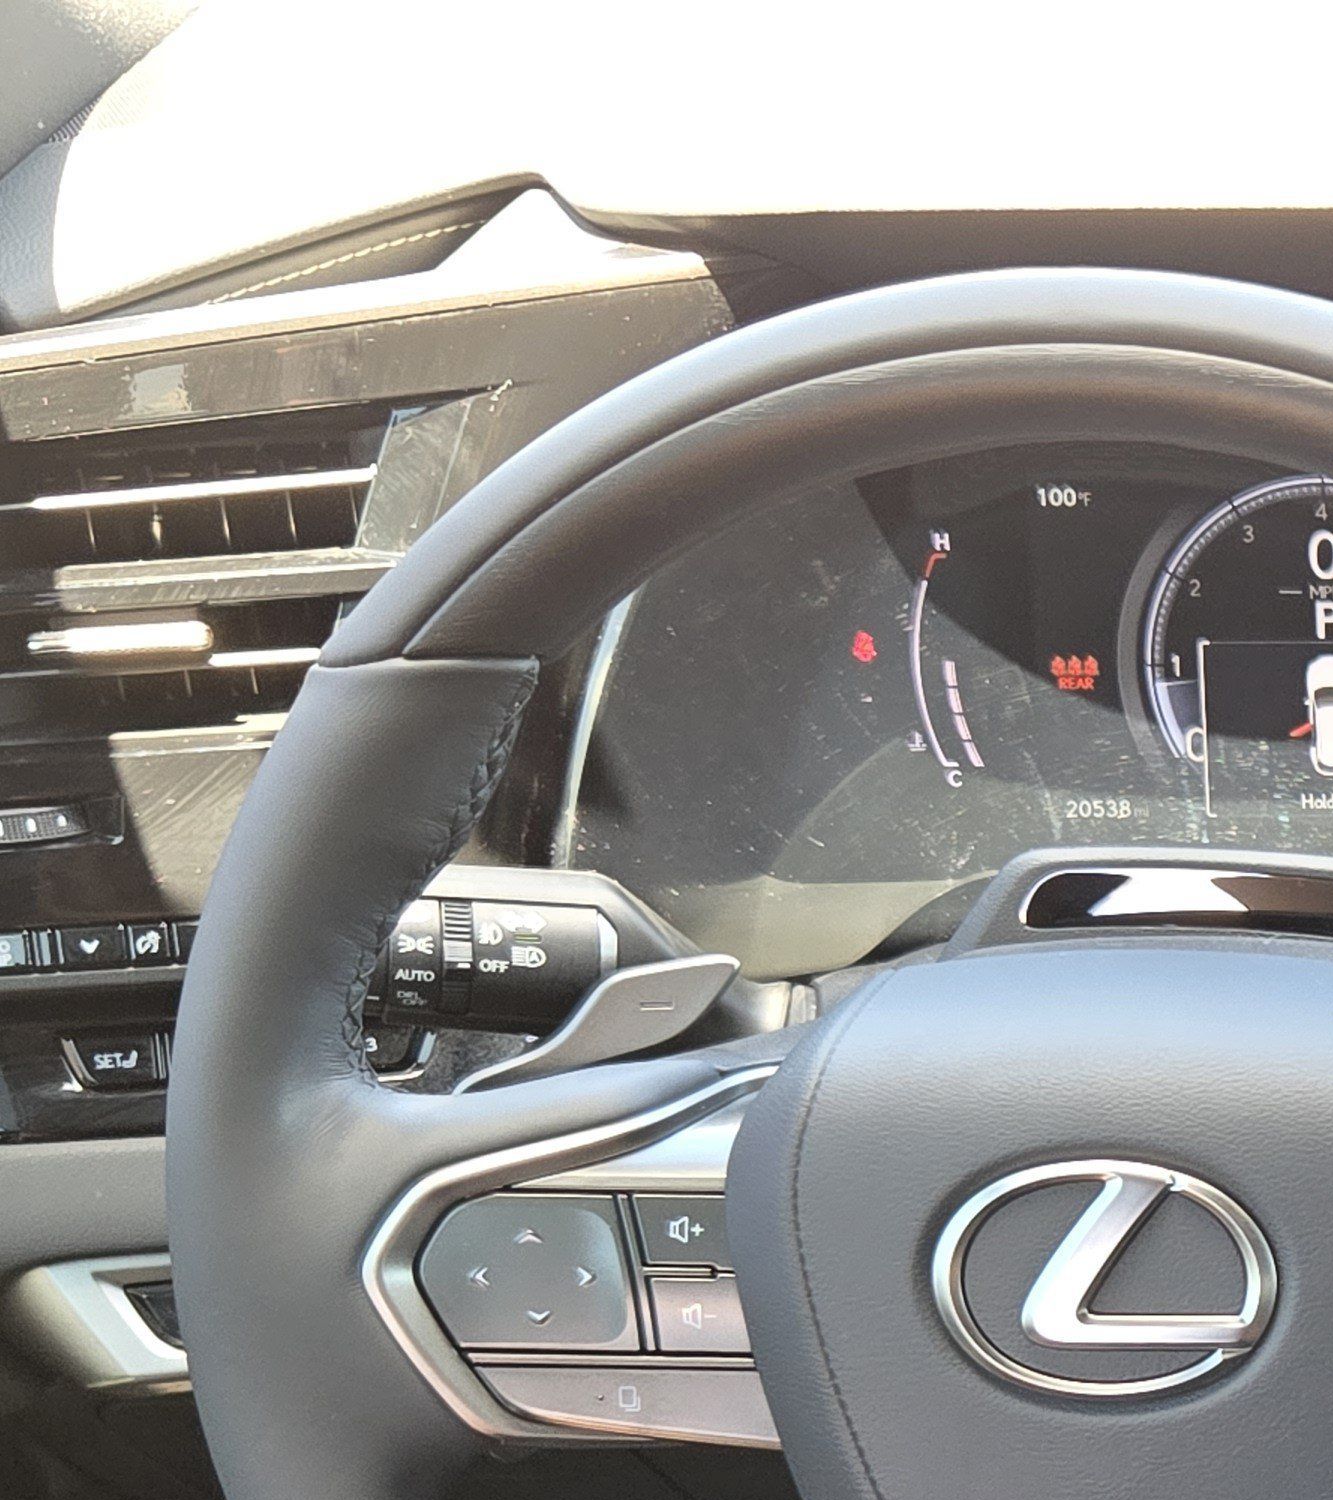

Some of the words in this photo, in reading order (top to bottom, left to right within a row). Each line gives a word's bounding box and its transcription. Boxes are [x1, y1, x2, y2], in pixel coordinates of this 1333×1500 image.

[1315, 502, 1328, 520] 4
[933, 532, 951, 552] H
[1242, 526, 1254, 543] 3
[1190, 579, 1201, 598] 2
[1058, 676, 1095, 691] REAR
[946, 769, 963, 788] C
[478, 958, 510, 973] OFF
[395, 968, 435, 982] AUTO
[93, 1052, 123, 1070] SET
